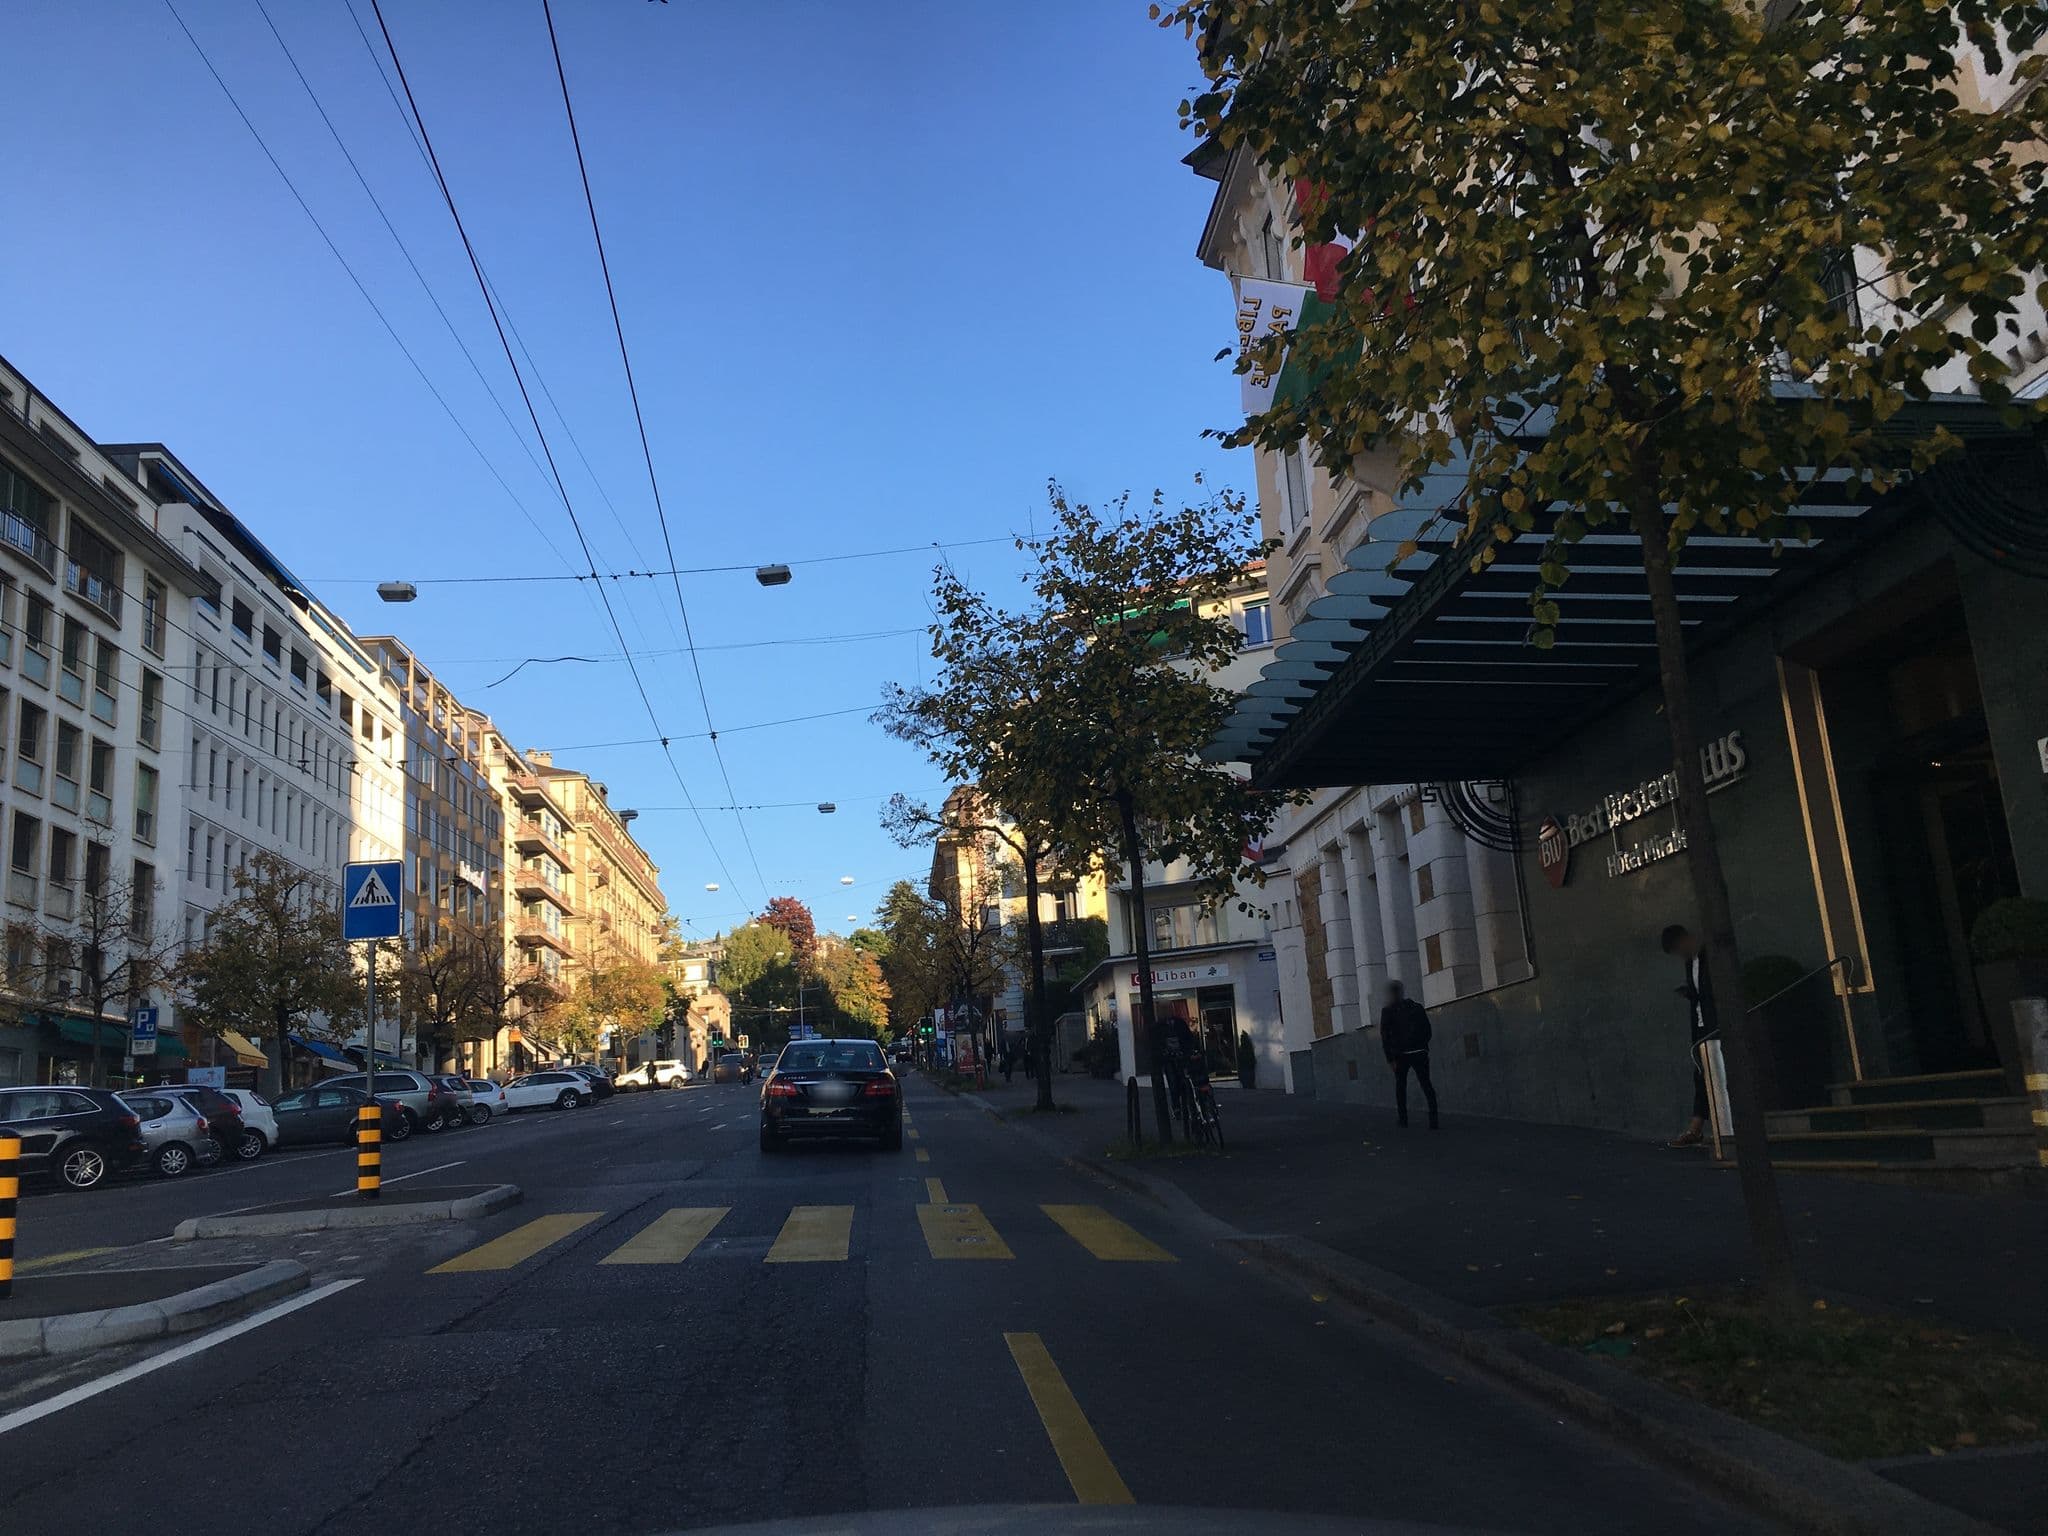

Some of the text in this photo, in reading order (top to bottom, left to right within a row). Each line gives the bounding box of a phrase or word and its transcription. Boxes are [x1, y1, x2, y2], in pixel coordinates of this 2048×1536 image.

[1567, 729, 1746, 849] Best Western LUS
[1541, 833, 1562, 868] BW
[1156, 970, 1196, 983] Liban
[136, 1010, 150, 1029] P
